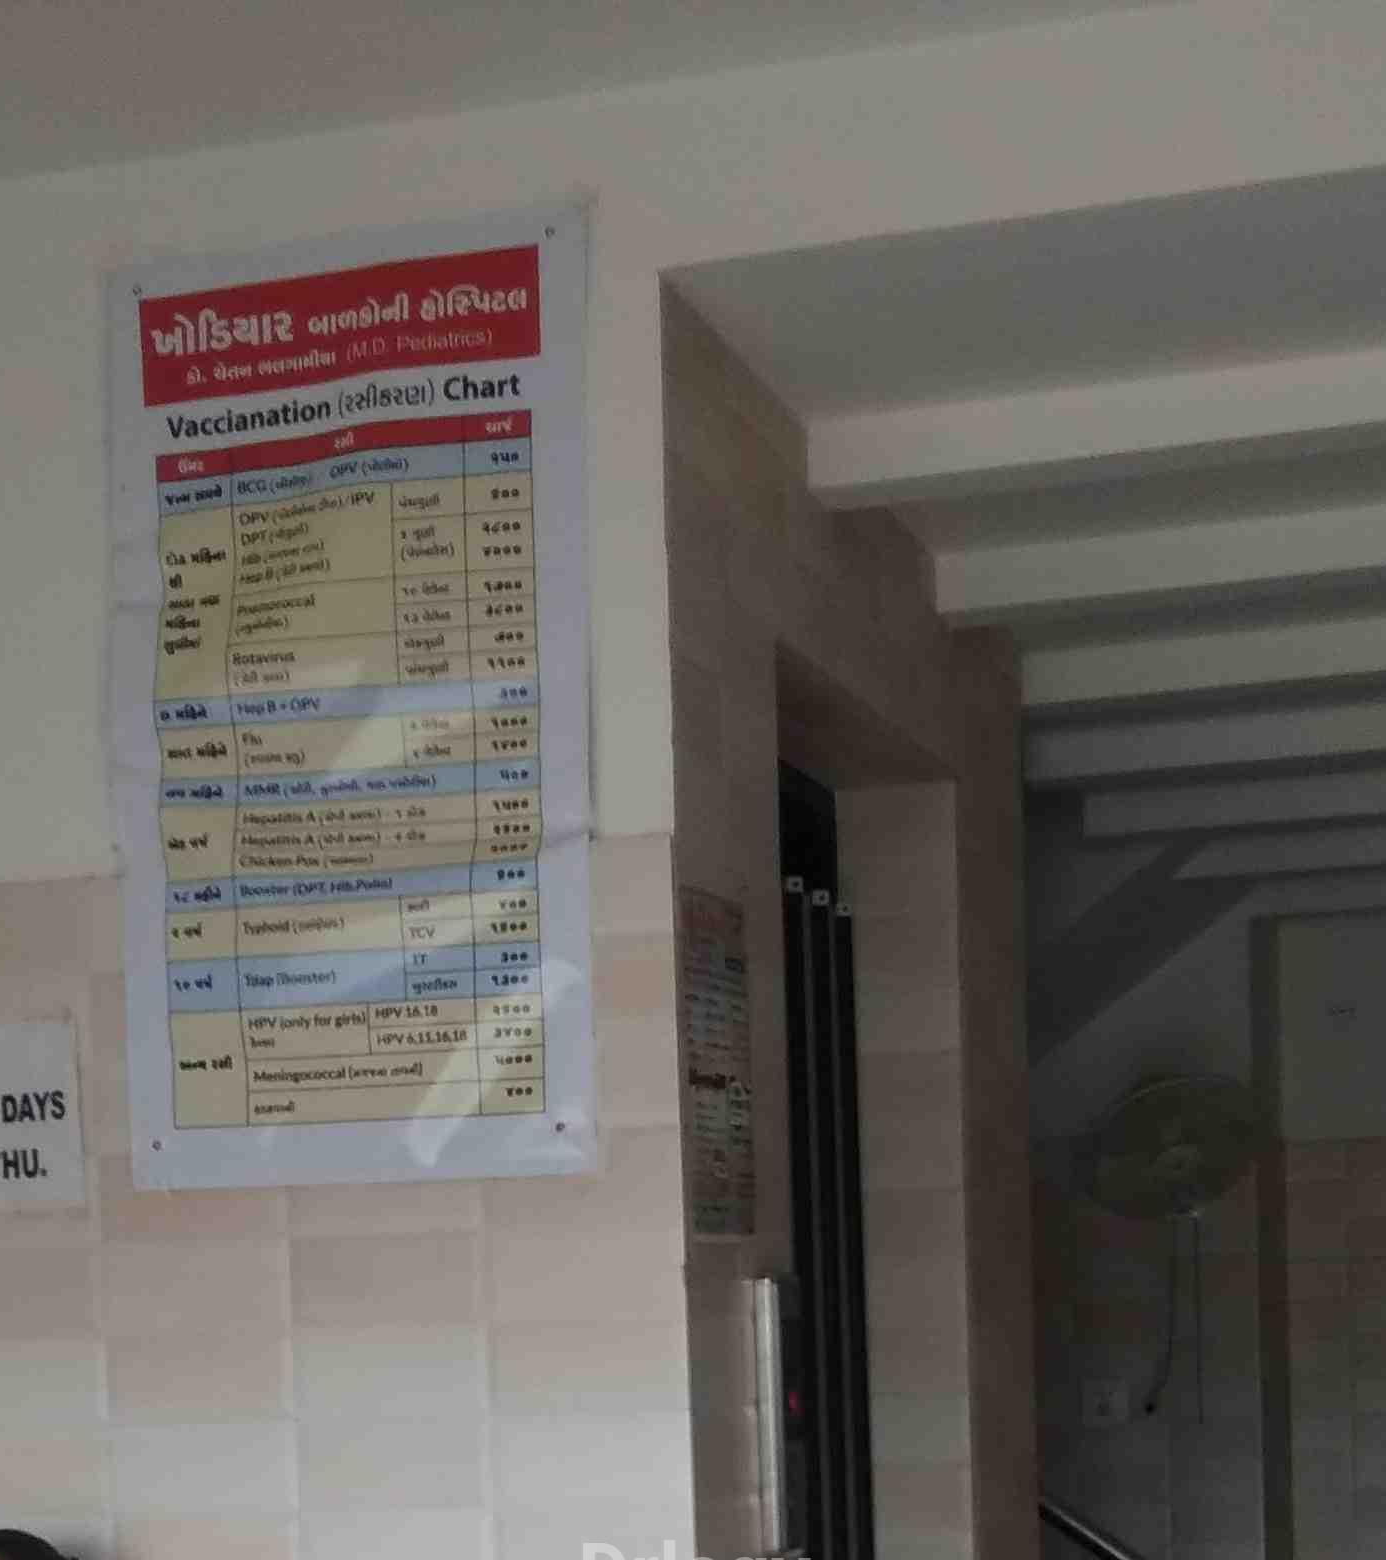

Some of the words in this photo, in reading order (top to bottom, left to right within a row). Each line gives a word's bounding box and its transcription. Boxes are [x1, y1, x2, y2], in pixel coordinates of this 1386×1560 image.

[150, 309, 294, 359] ખોડિયાર
[308, 291, 410, 337] બાળકોની
[420, 283, 528, 322] હોસ્પિટલ
[397, 328, 493, 352] Pediatrics)
[167, 399, 331, 439] Vaccianation
[443, 372, 521, 402] Chart
[247, 1016, 277, 1031] HPV
[280, 1017, 310, 1032] (only
[314, 1014, 332, 1026] for
[335, 1011, 367, 1028] girls)
[375, 1006, 401, 1019] HPV
[377, 1033, 405, 1047] HPV
[253, 1066, 346, 1083] Meningococcal
[2, 1090, 66, 1123] DAYS
